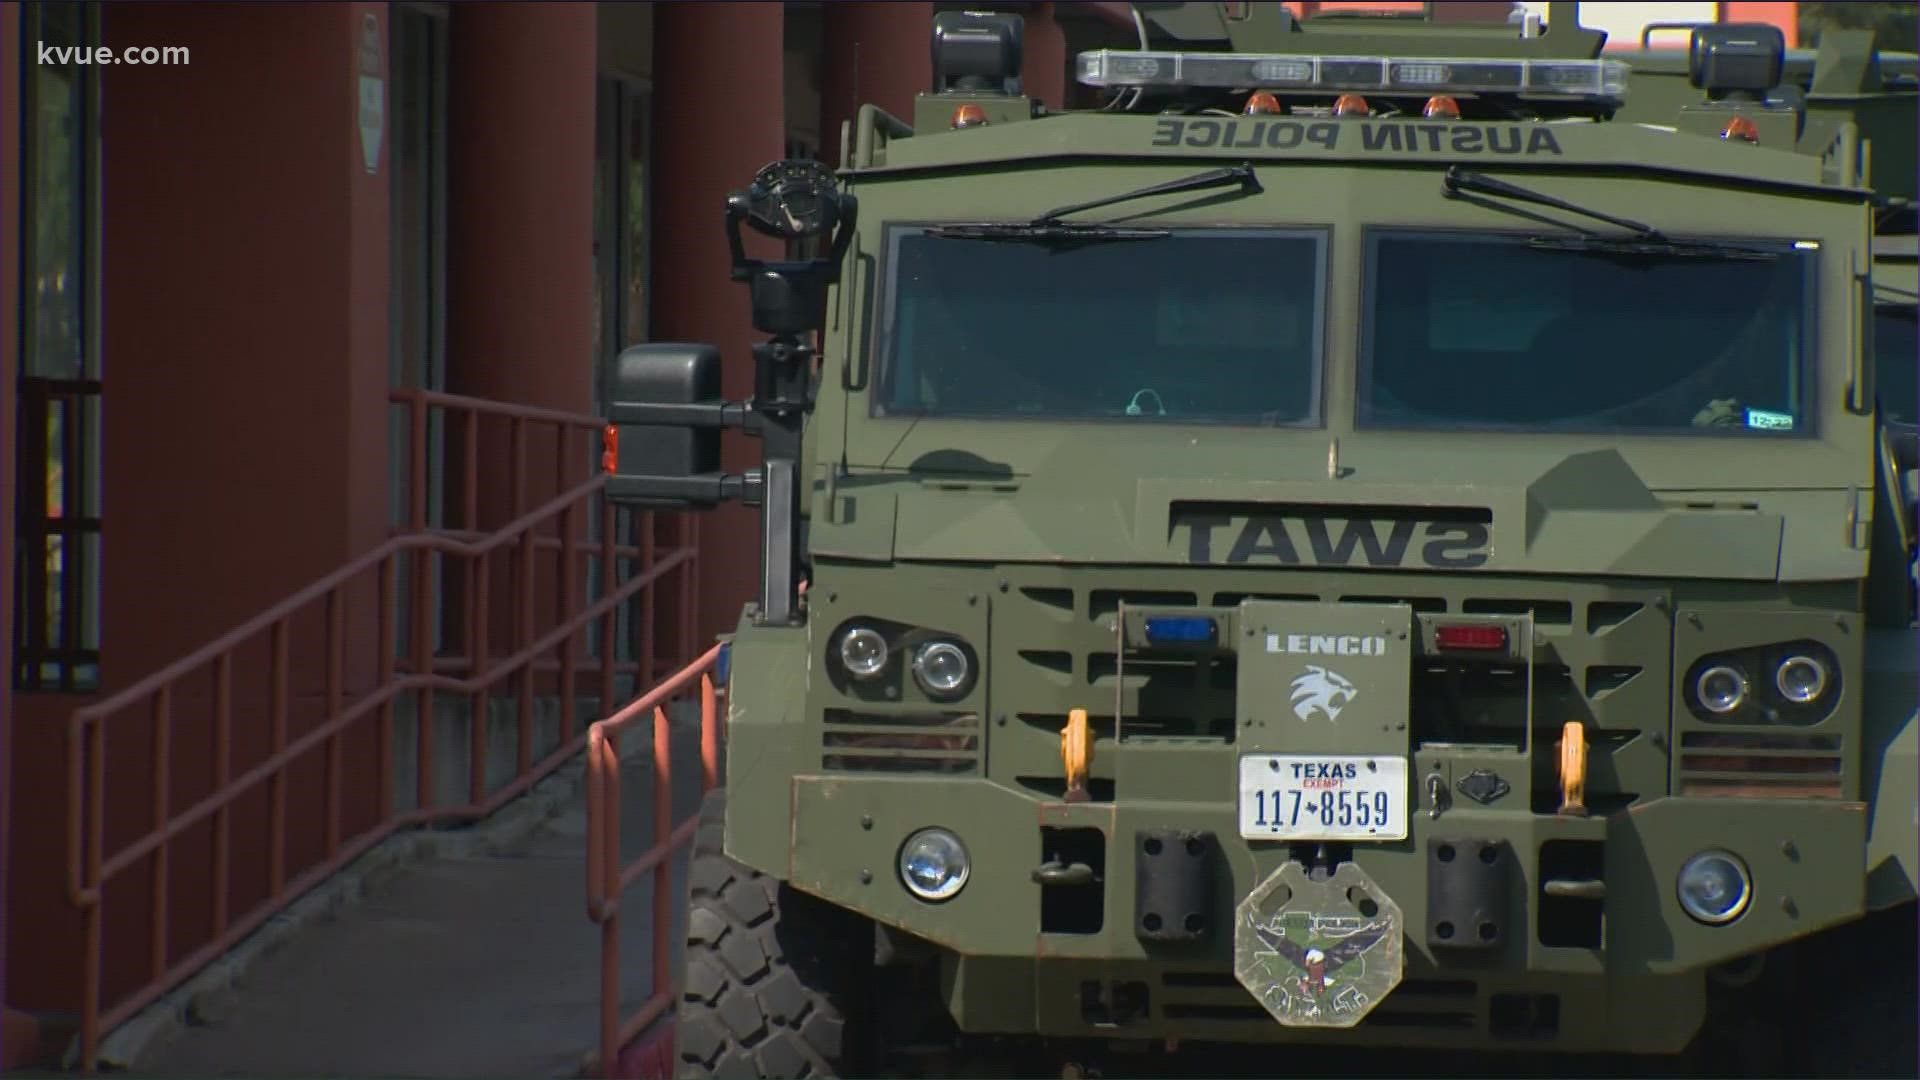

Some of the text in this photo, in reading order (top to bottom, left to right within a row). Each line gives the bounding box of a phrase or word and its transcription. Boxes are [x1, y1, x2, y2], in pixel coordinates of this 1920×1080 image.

[1266, 633, 1385, 656] LENCO
[1291, 763, 1357, 779] TEXAS
[1303, 778, 1344, 789] EXEMPT
